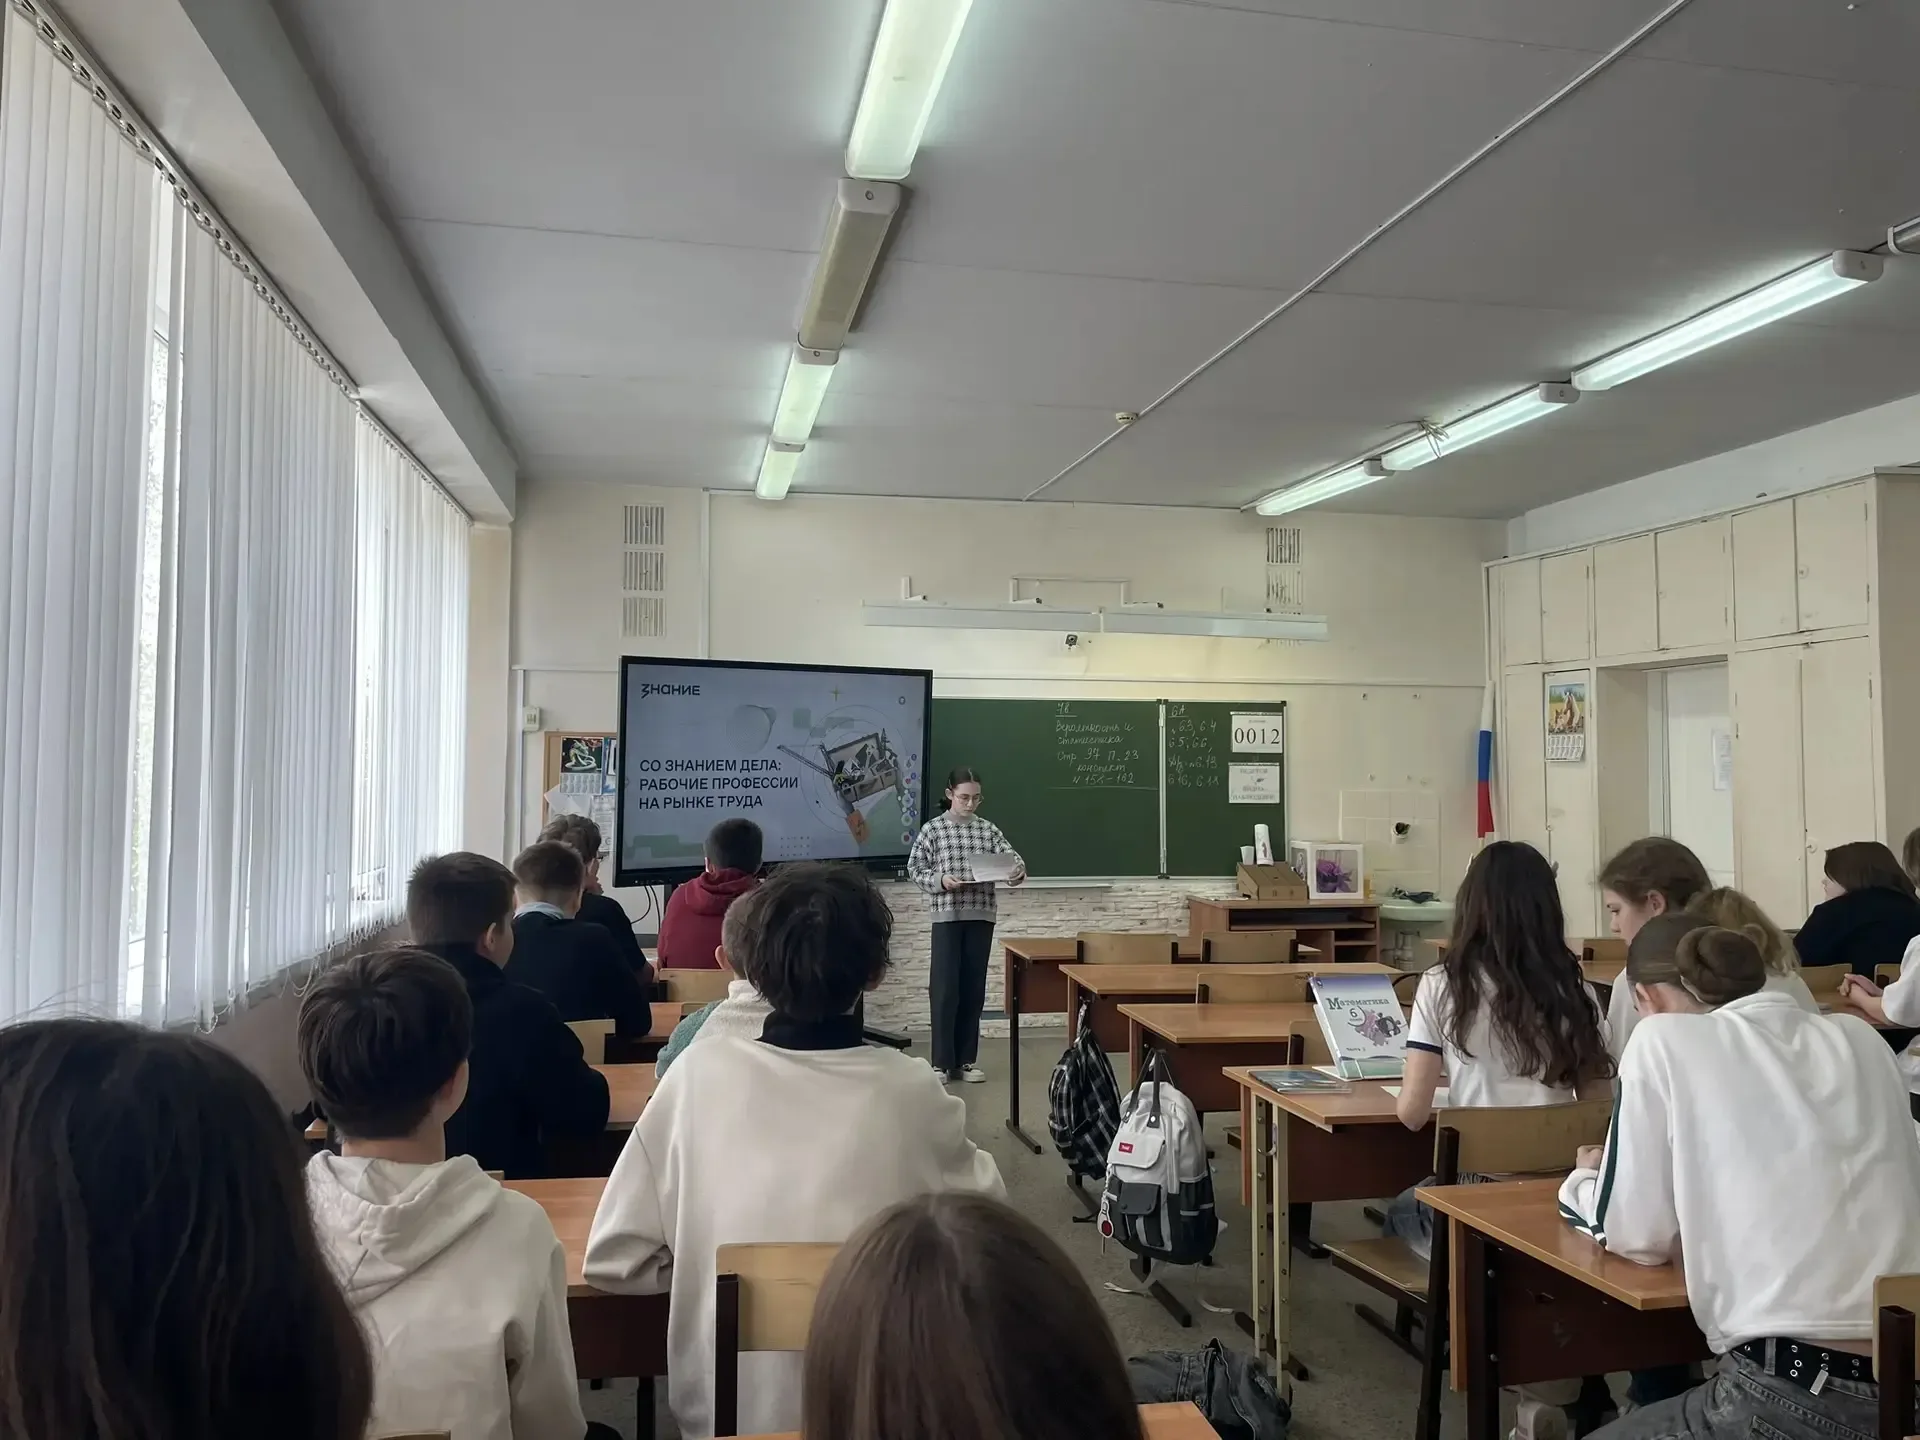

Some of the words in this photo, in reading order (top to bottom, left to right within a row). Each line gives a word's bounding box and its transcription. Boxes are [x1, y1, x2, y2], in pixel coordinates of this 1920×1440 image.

[1234, 727, 1281, 745] 0012
[1124, 749, 1139, 760] 23
[640, 759, 661, 772] СО
[665, 759, 737, 772] ЗНАНИЕМ
[740, 759, 782, 774] ДЕЛА:
[640, 778, 709, 791] РАБОЧИЕ
[712, 777, 798, 790] ПРОФЕССИИ
[639, 797, 660, 810] НА
[663, 796, 715, 809] РЫНКЕ
[718, 795, 763, 809] ТРУДА
[1326, 997, 1390, 1010] Математика
[1349, 1008, 1358, 1018] 6
